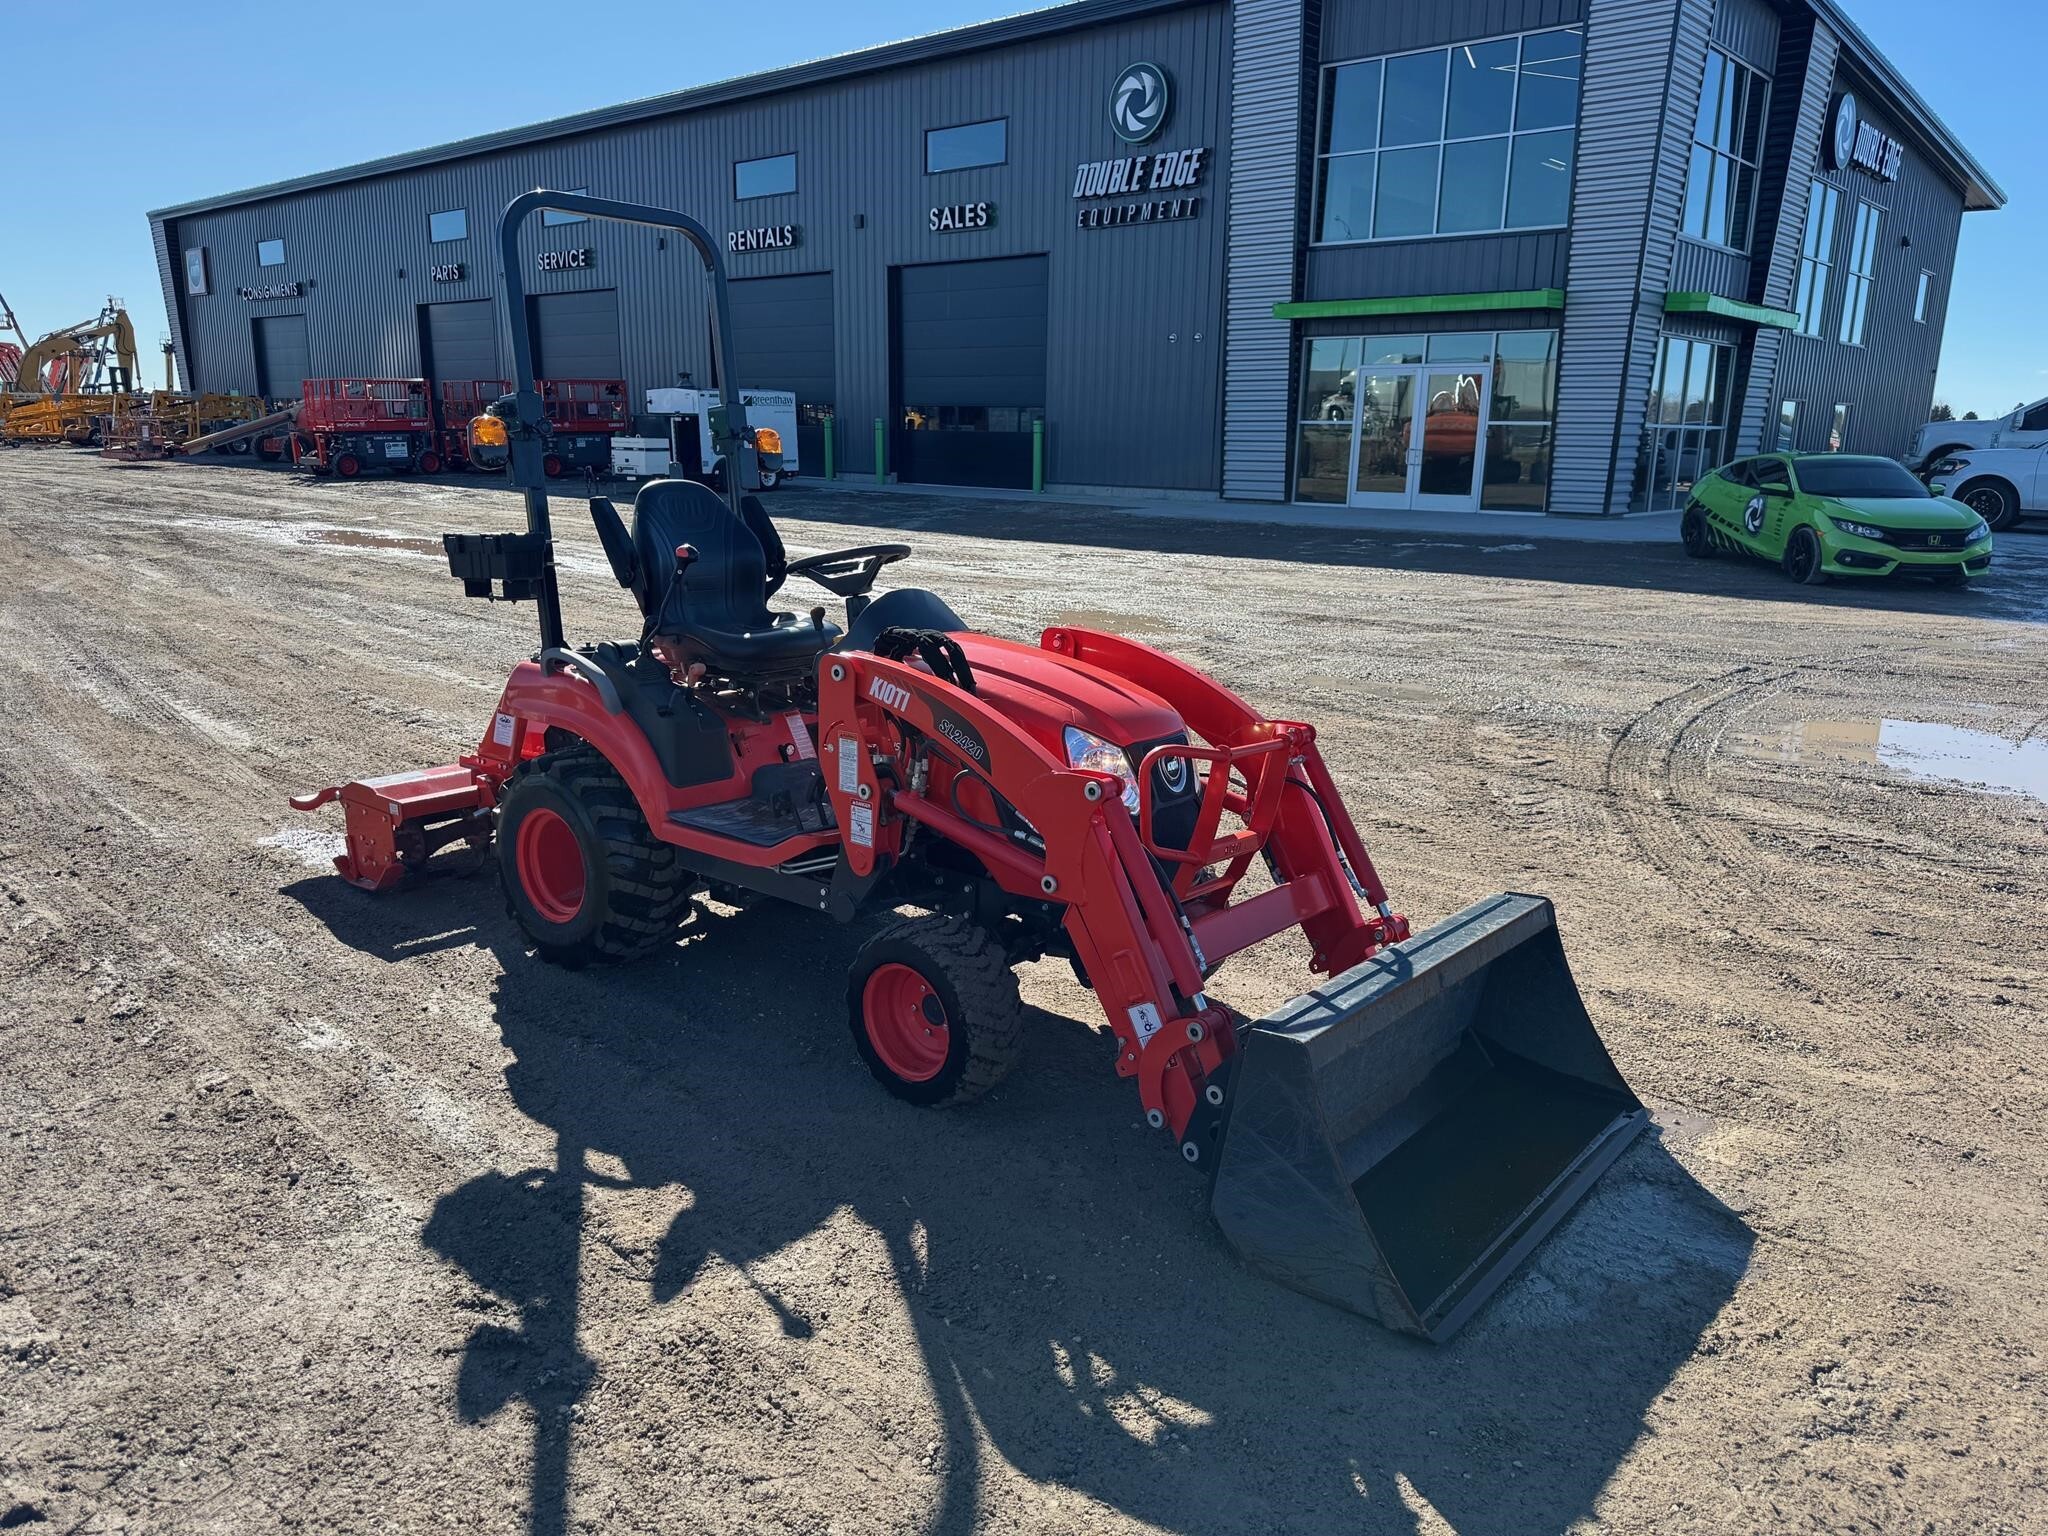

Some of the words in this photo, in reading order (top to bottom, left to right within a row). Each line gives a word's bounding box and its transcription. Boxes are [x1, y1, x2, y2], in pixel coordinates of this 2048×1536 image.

[1853, 120, 1885, 172] DOUBLE
[1881, 138, 1904, 182] EDGE
[1073, 156, 1146, 197] DOUBLE
[1150, 148, 1203, 189] EDGE
[929, 202, 987, 231] SALES
[1078, 198, 1194, 227] EQUIPMENT
[728, 225, 793, 251] RENTALS
[431, 264, 459, 281] PARTS
[537, 249, 585, 270] SERVICE
[242, 282, 298, 300] CONSIGNMENTS
[869, 676, 911, 713] KIOTI
[938, 719, 984, 761] SL2420
